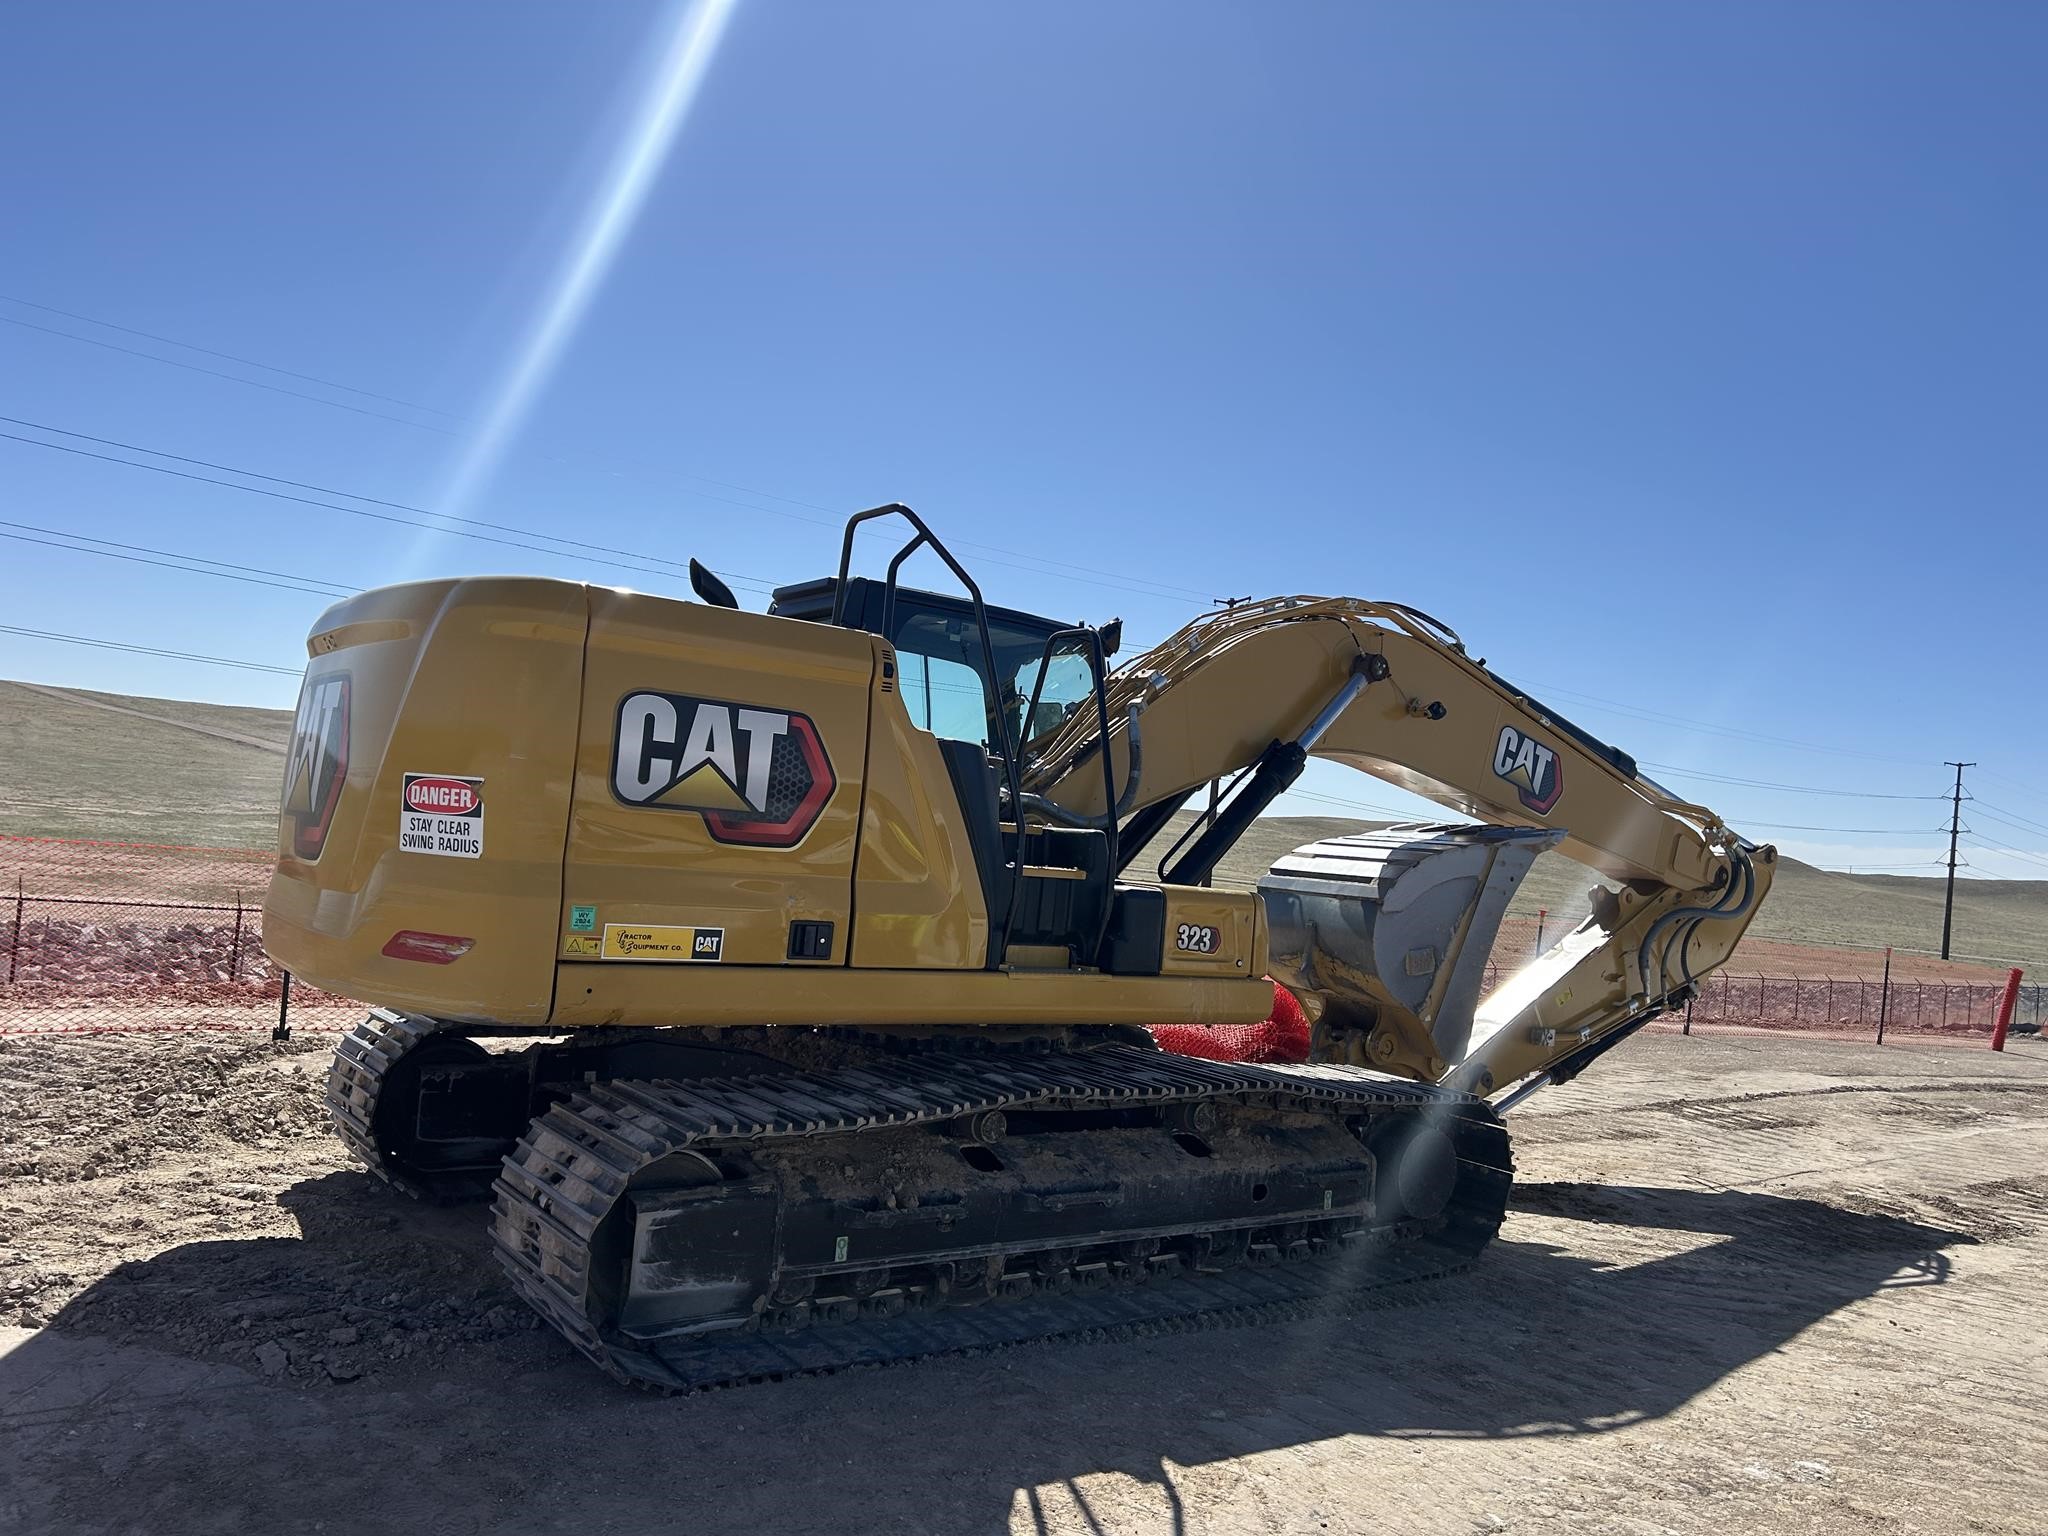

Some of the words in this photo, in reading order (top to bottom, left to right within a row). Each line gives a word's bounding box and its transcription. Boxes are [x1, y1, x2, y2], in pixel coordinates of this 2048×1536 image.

[615, 694, 789, 812] CAT
[1494, 726, 1553, 795] CAT
[410, 785, 472, 808] DANGER
[409, 817, 433, 833] STAY
[437, 819, 470, 836] CLEAR
[402, 833, 434, 850] SWING
[438, 837, 479, 854] RADIUS
[617, 930, 652, 943] TRACTOR
[695, 936, 719, 953] CAT
[1177, 924, 1211, 952] 323
[623, 941, 669, 954] EQUIPMENT
